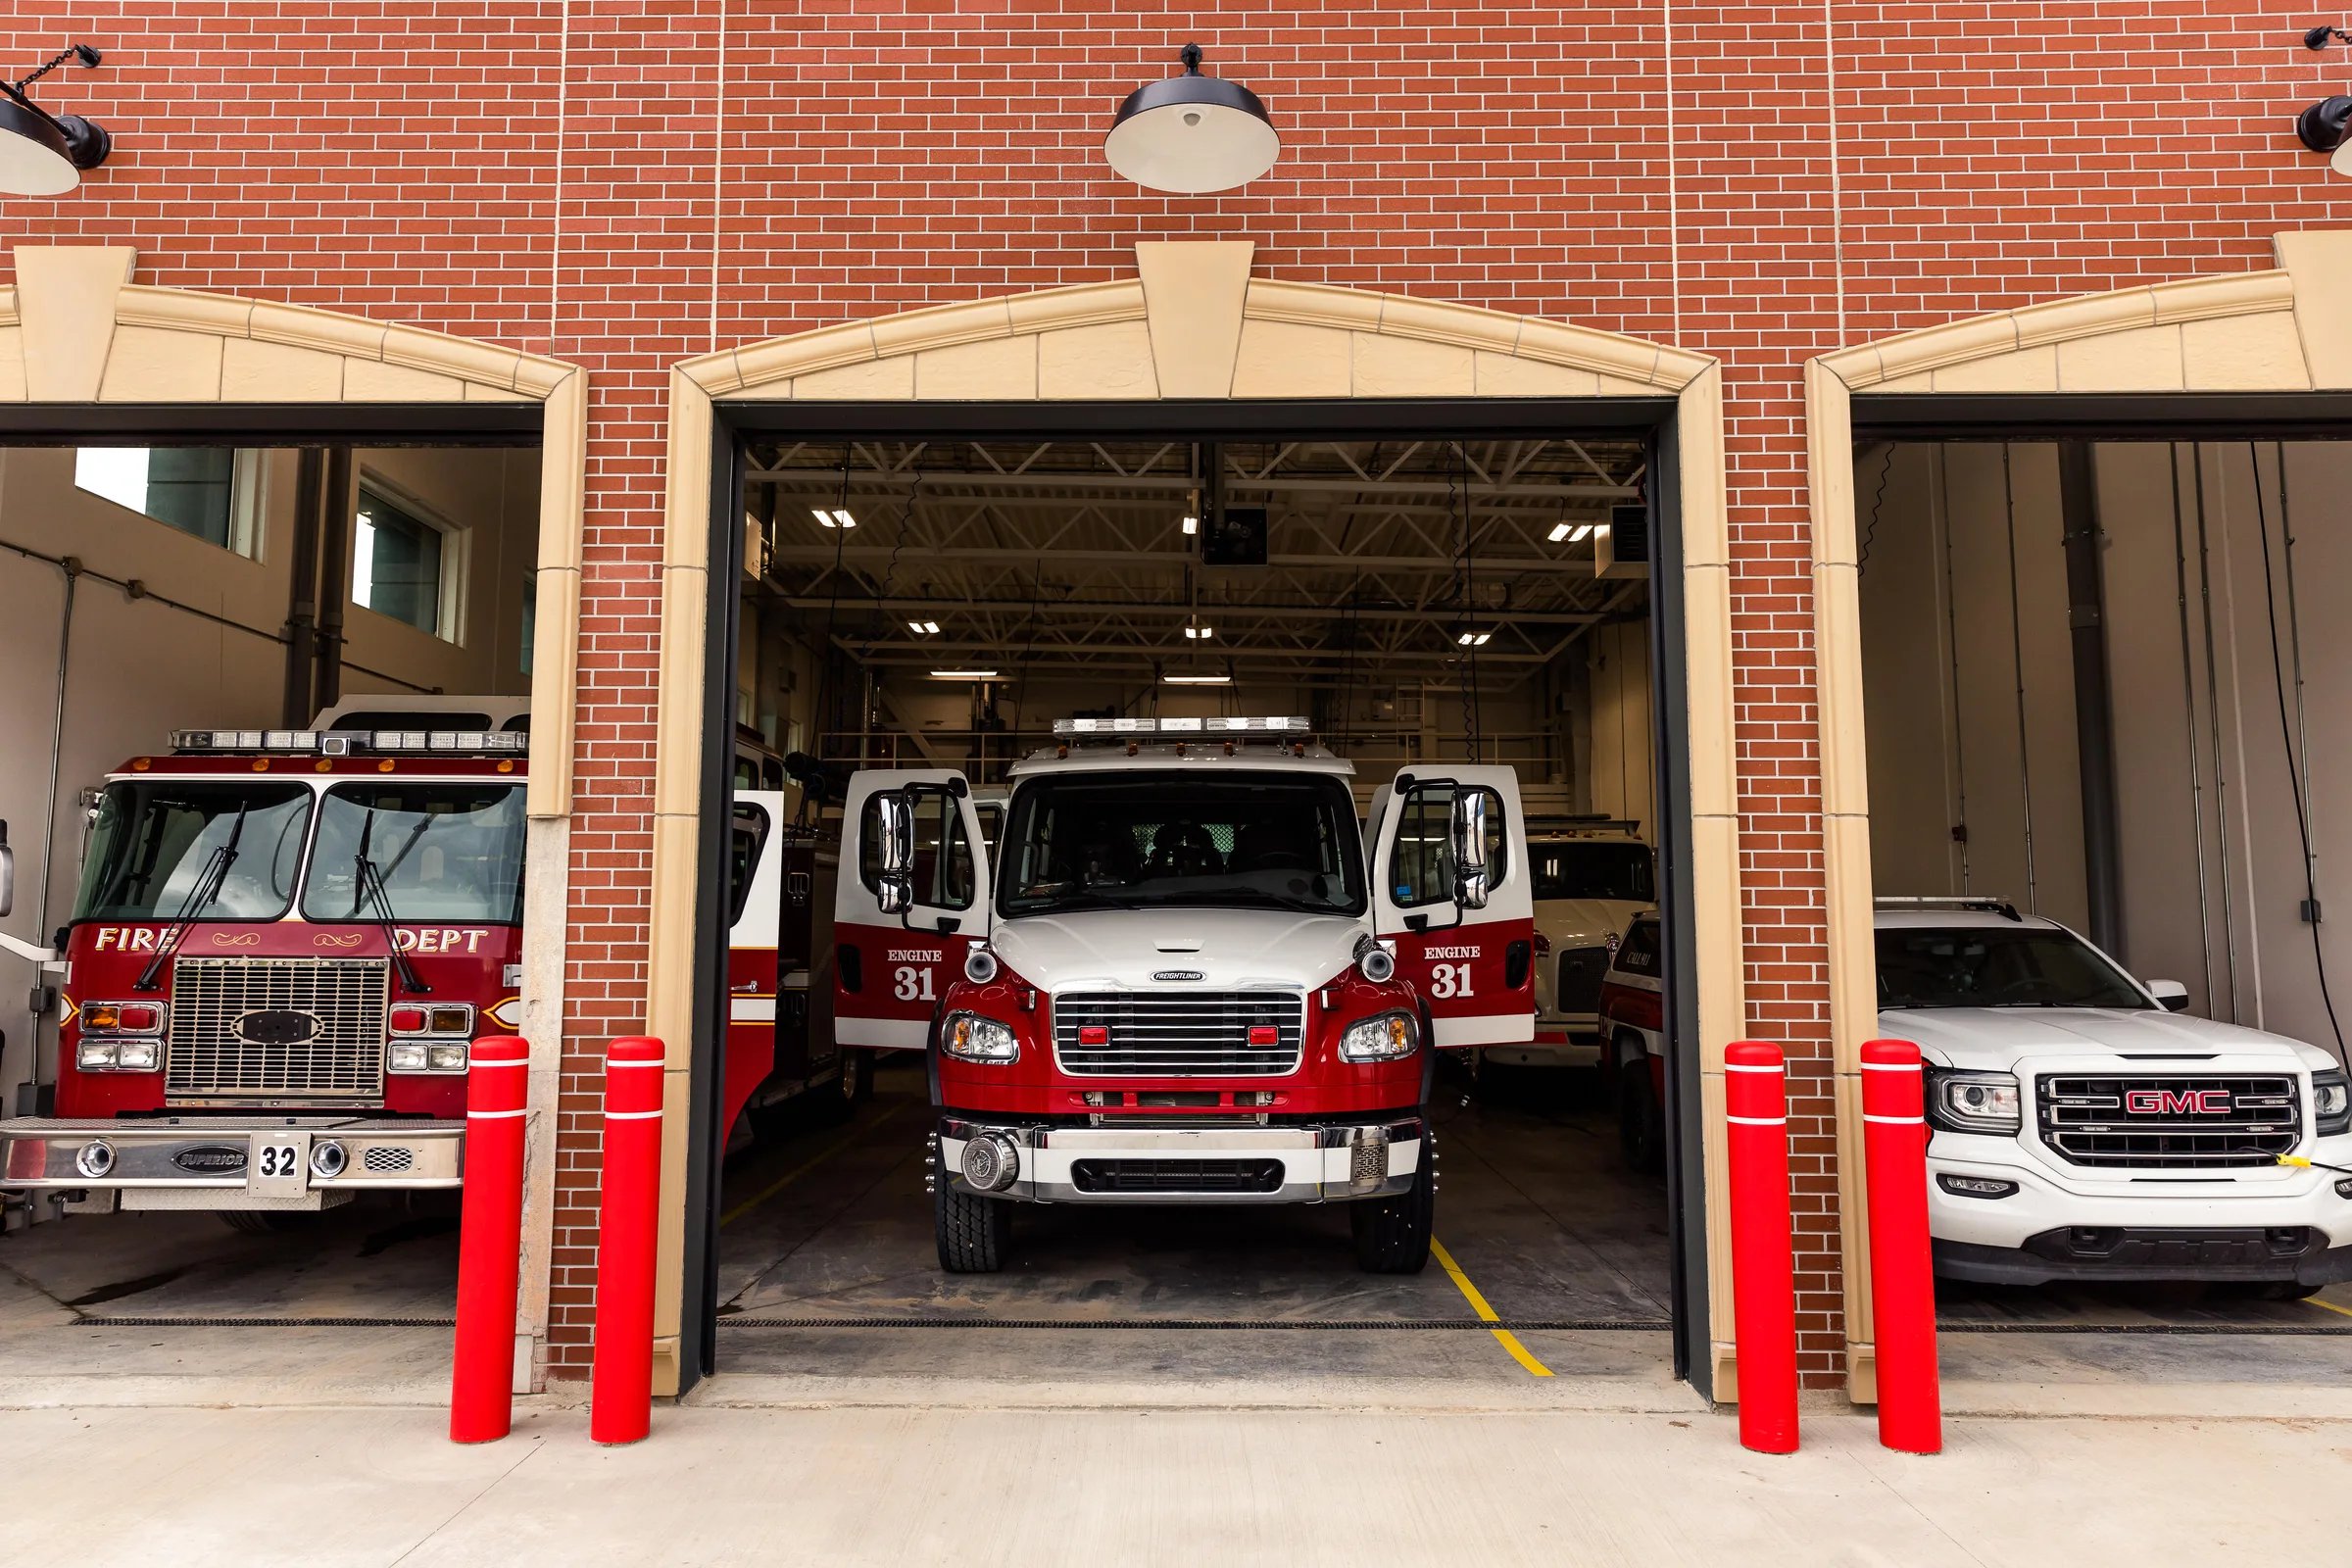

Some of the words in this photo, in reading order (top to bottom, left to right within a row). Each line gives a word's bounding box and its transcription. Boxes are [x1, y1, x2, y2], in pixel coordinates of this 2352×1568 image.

[95, 927, 179, 951] FIRE
[392, 928, 489, 953] DEPT
[887, 950, 942, 961] ENGINE
[1424, 946, 1481, 959] ENGINE
[1627, 952, 1642, 964] CALL
[895, 966, 936, 1001] 31
[1431, 963, 1474, 999] 31
[2126, 1090, 2231, 1114] GMC
[179, 1153, 245, 1165] SUPERIOR
[261, 1147, 296, 1176] 32
